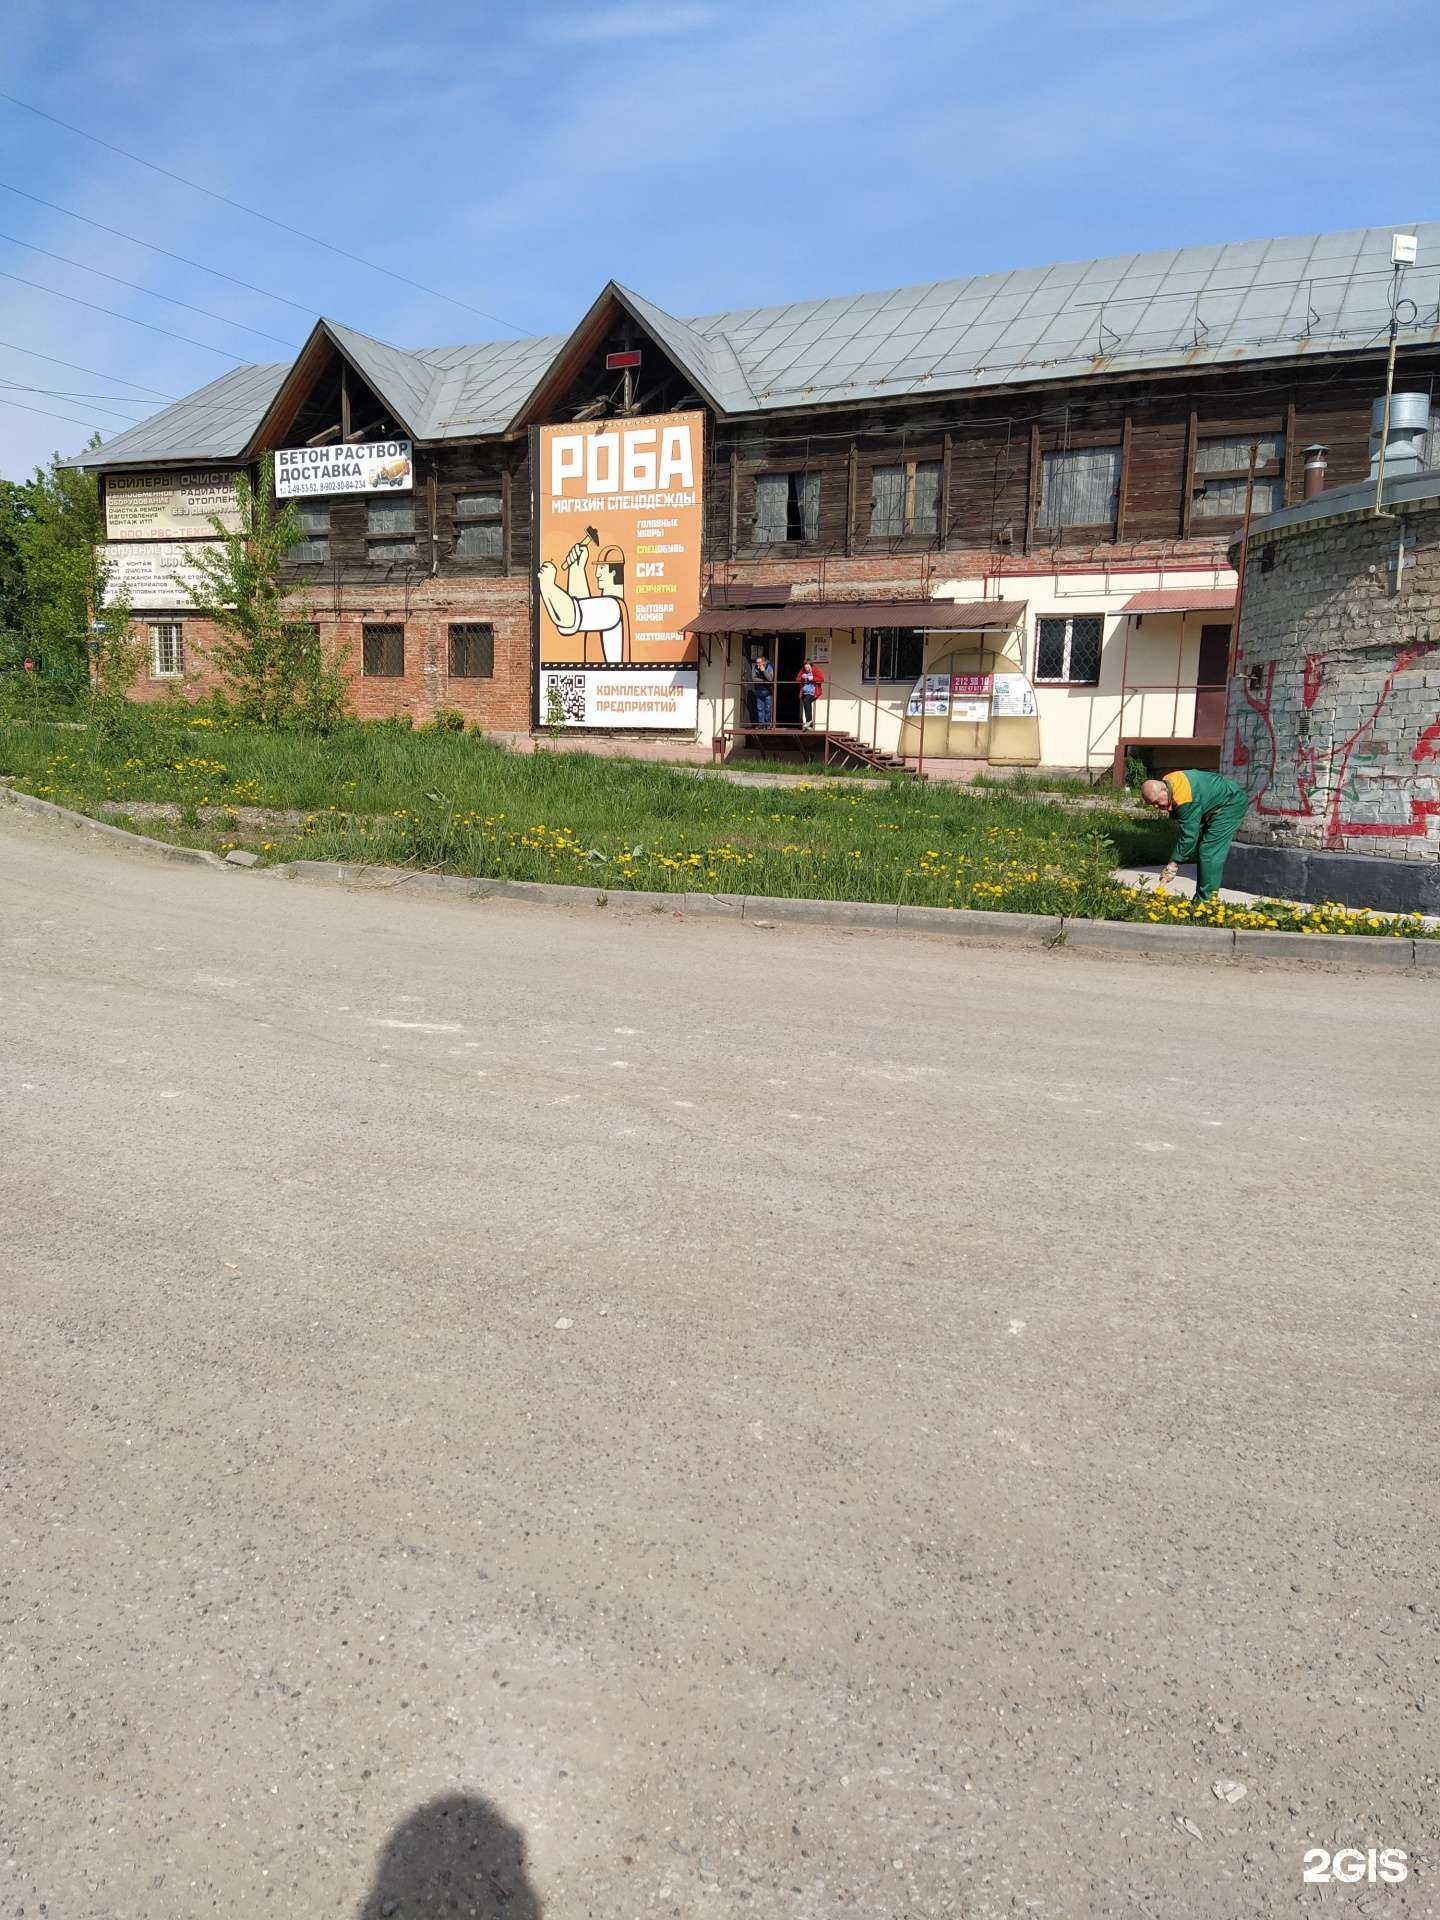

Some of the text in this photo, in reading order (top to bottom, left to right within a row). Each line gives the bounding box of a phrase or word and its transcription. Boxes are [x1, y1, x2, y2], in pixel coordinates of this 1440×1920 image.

[279, 442, 409, 466] БЕТОН РАСТВОР
[551, 425, 695, 497] РОБА
[181, 471, 237, 486] ОЧИСТК
[279, 463, 362, 485] ДОСТАВКА
[551, 491, 696, 513] МАГАЗИН СПЕЦОДЕЖДЫ
[637, 544, 685, 554] СПЕЦОБУВЬ
[635, 562, 665, 578] СИЗ
[635, 584, 678, 594] ПЕРЧАТКИ
[635, 603, 674, 613] БЫТОВАЯ
[634, 632, 684, 641] ХОЗТОВАРЫ
[596, 685, 684, 698] КОМПЛЕКТАЦИЯ
[596, 699, 677, 713] ПРЕДПРИЯТИЙ
